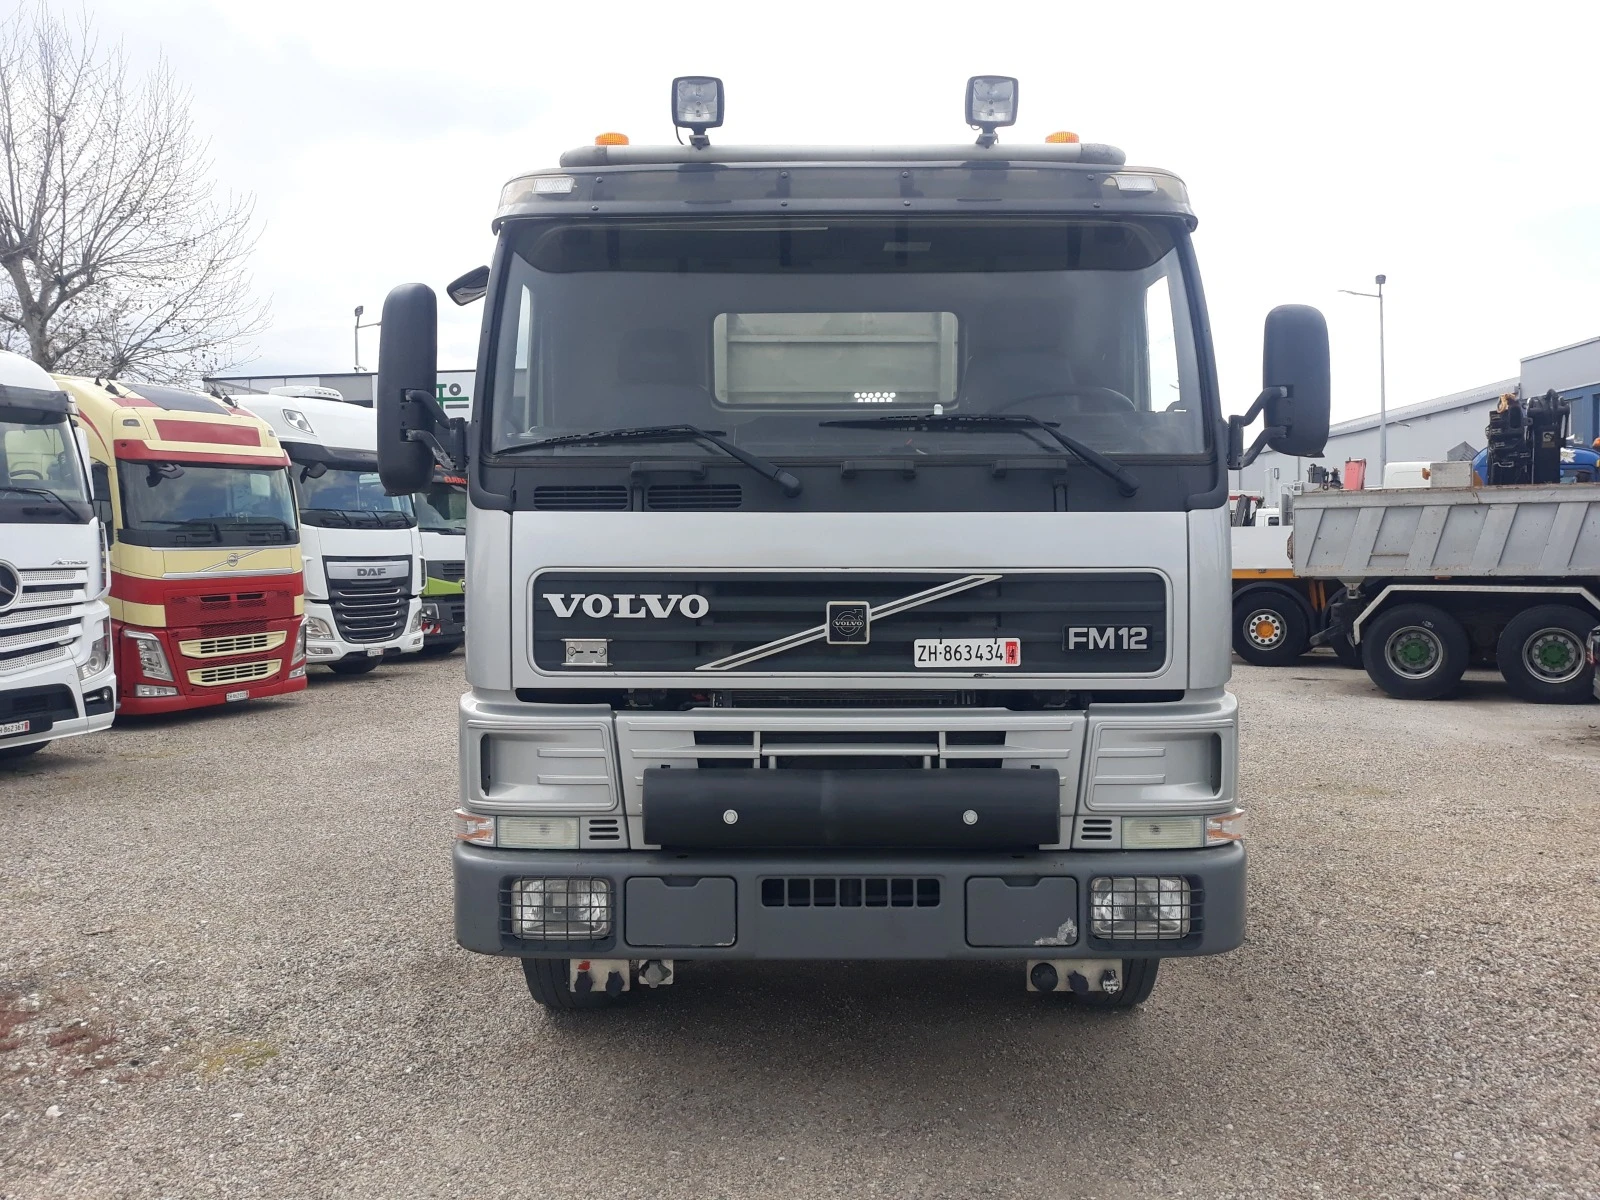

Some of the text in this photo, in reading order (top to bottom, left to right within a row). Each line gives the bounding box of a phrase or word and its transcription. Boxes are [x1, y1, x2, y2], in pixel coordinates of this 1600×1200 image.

[357, 567, 386, 576] DAF
[542, 593, 710, 619] VOLVO
[1068, 627, 1148, 650] FM12
